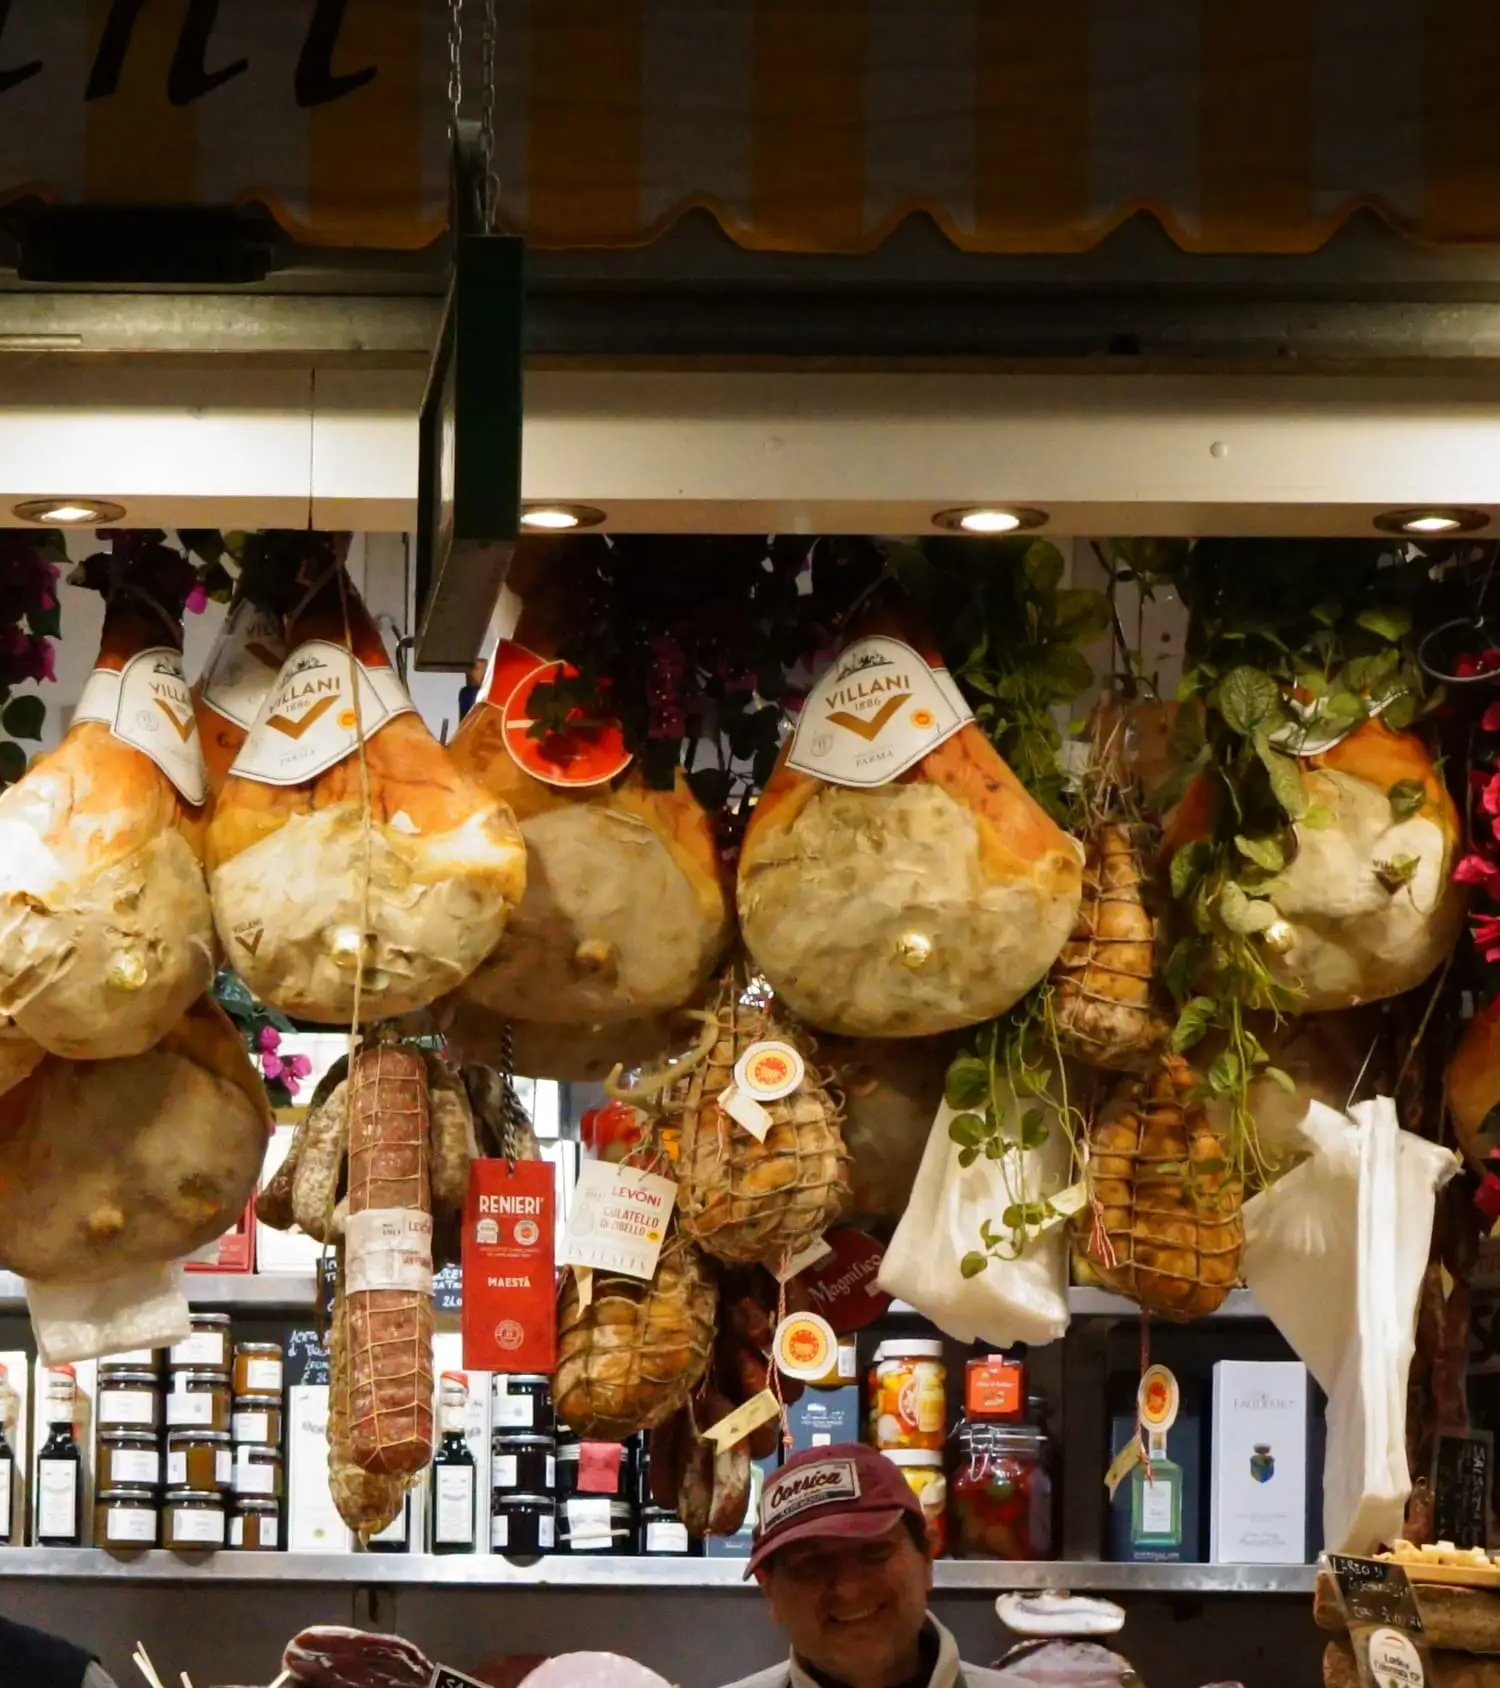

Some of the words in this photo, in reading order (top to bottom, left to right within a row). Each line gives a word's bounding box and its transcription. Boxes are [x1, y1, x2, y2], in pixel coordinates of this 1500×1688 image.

[268, 675, 342, 713] VILLANI
[824, 674, 911, 709] VILLANI
[854, 697, 883, 713] 1886
[855, 750, 895, 767] PARMA
[479, 1194, 542, 1215] RENIERI
[610, 1185, 663, 1208] LEVONI
[602, 1206, 660, 1229] CULATELLO
[806, 1252, 883, 1307] Magnifico
[770, 1469, 843, 1509] Corsica
